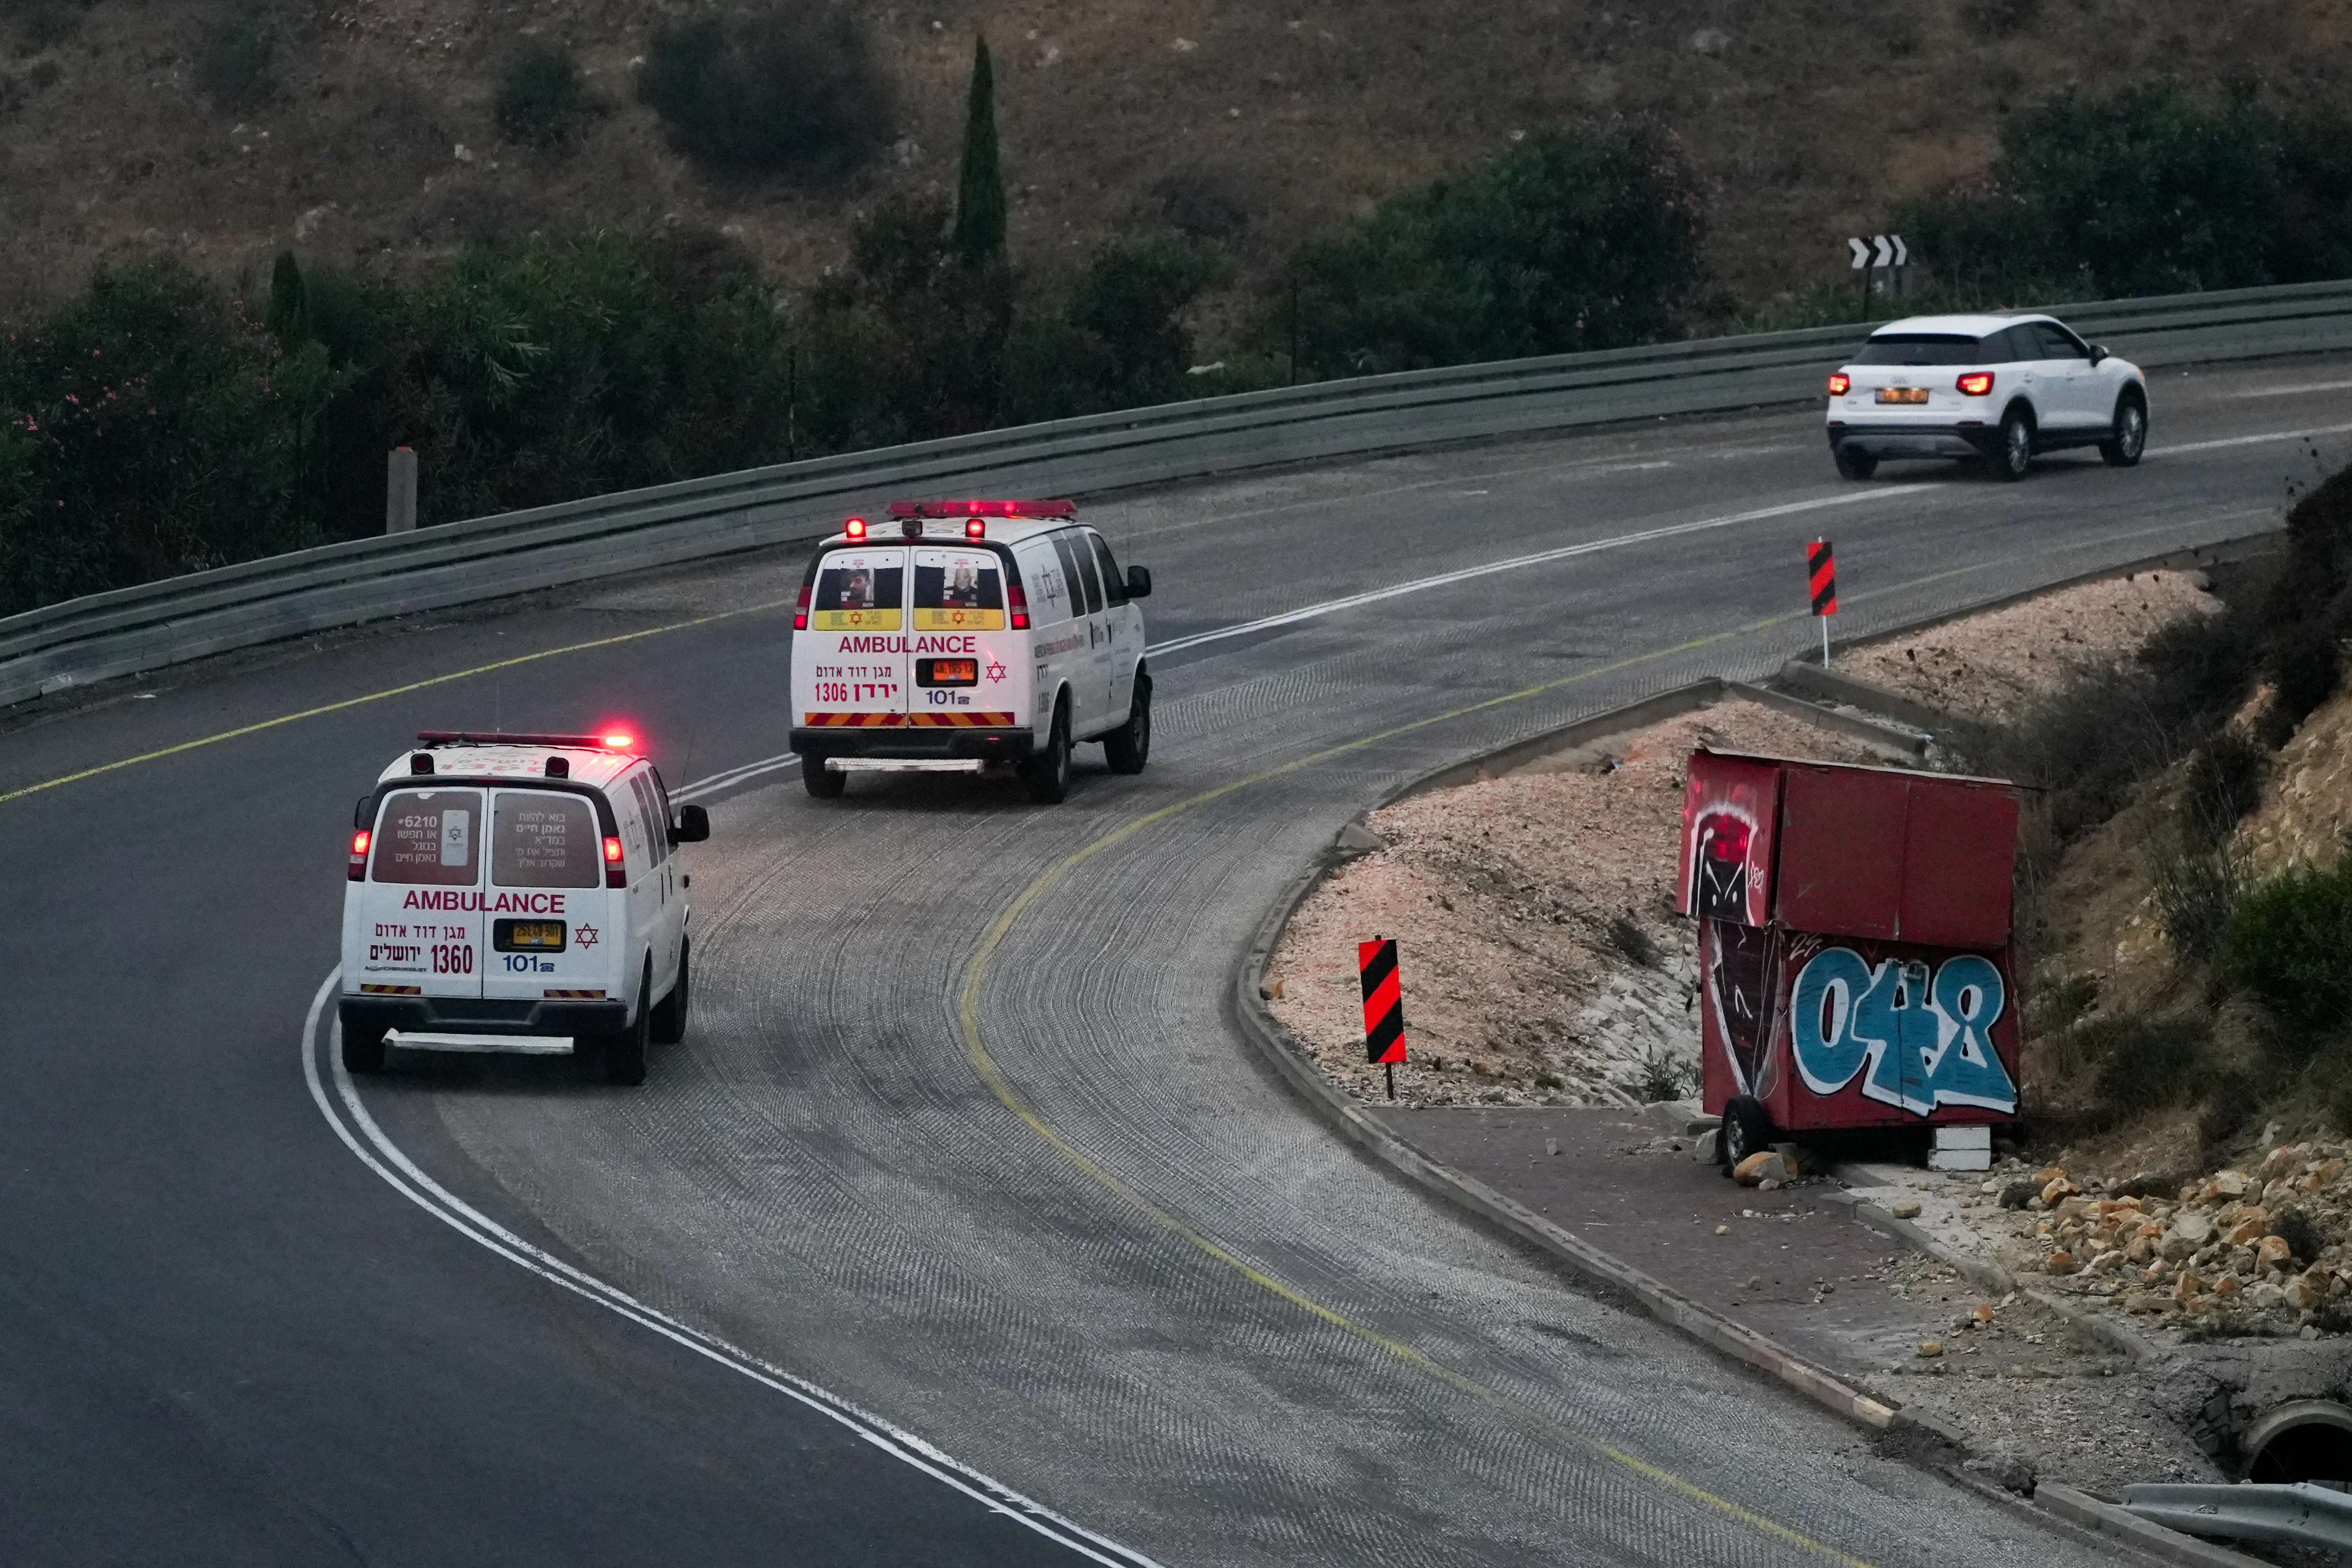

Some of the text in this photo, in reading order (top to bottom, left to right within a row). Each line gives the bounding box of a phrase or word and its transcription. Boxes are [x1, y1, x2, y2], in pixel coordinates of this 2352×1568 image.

[839, 636, 975, 653] AMBULANCE
[816, 666, 891, 680] מגן דוד אדום
[815, 683, 897, 702] ירדן 1306
[926, 690, 955, 704] 101
[519, 811, 566, 822] בוא להיות
[397, 830, 437, 839] או חפשו
[516, 824, 566, 835] נאמן חיים
[412, 839, 436, 851] בגוגל
[527, 848, 540, 856] את
[395, 853, 436, 864] נאמן חיים
[403, 890, 565, 913] AMBULANCE
[376, 923, 464, 941] מגן דוד אדום
[370, 943, 473, 974] 1360 ירושלים
[503, 955, 537, 972] 101
